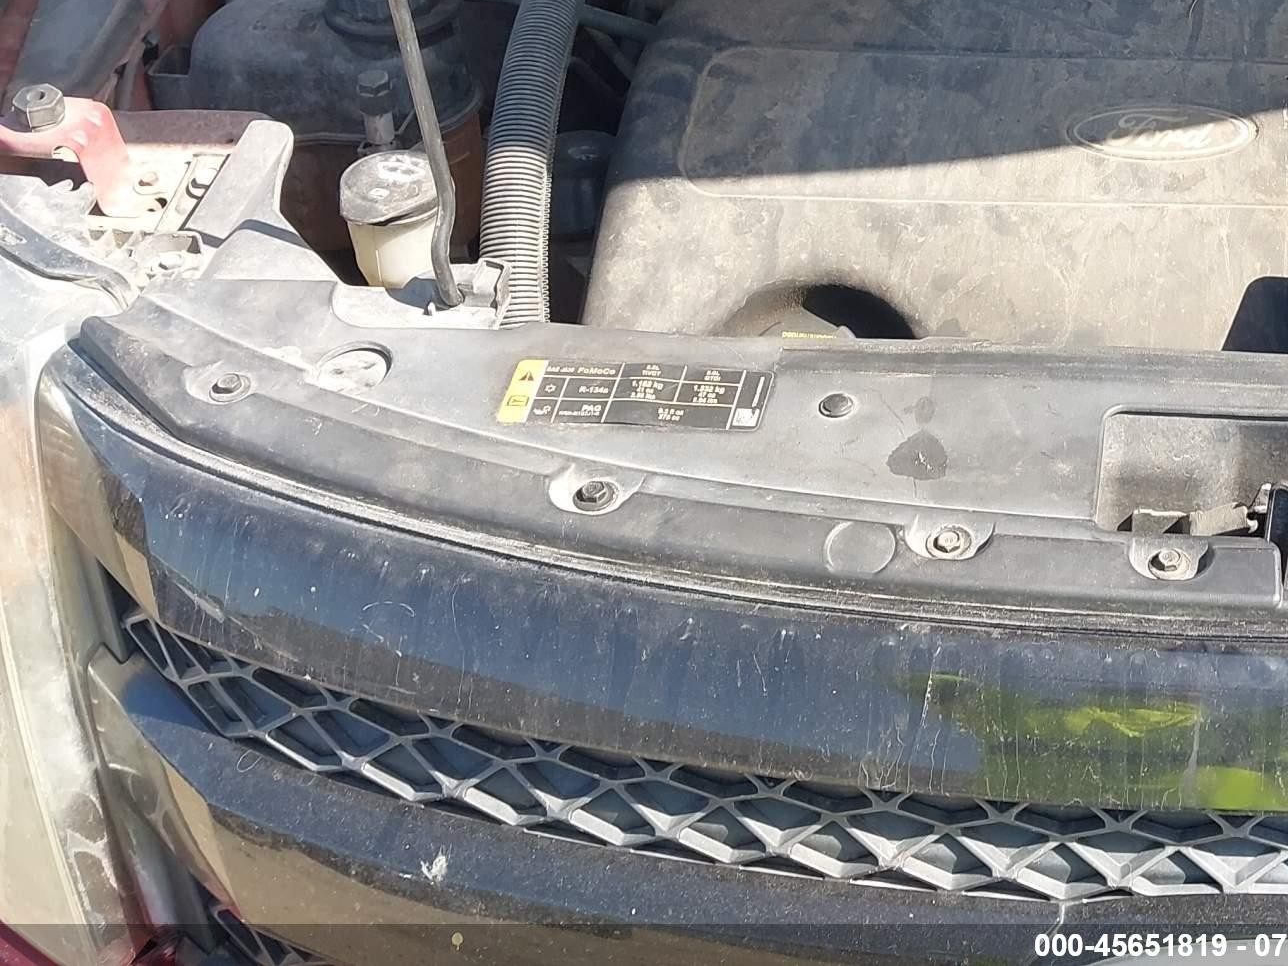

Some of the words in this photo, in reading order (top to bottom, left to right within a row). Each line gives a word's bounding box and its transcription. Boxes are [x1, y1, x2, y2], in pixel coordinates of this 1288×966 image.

[1106, 114, 1213, 147] Ford
[578, 367, 616, 375] FoMoCo
[579, 386, 609, 394] R-134a
